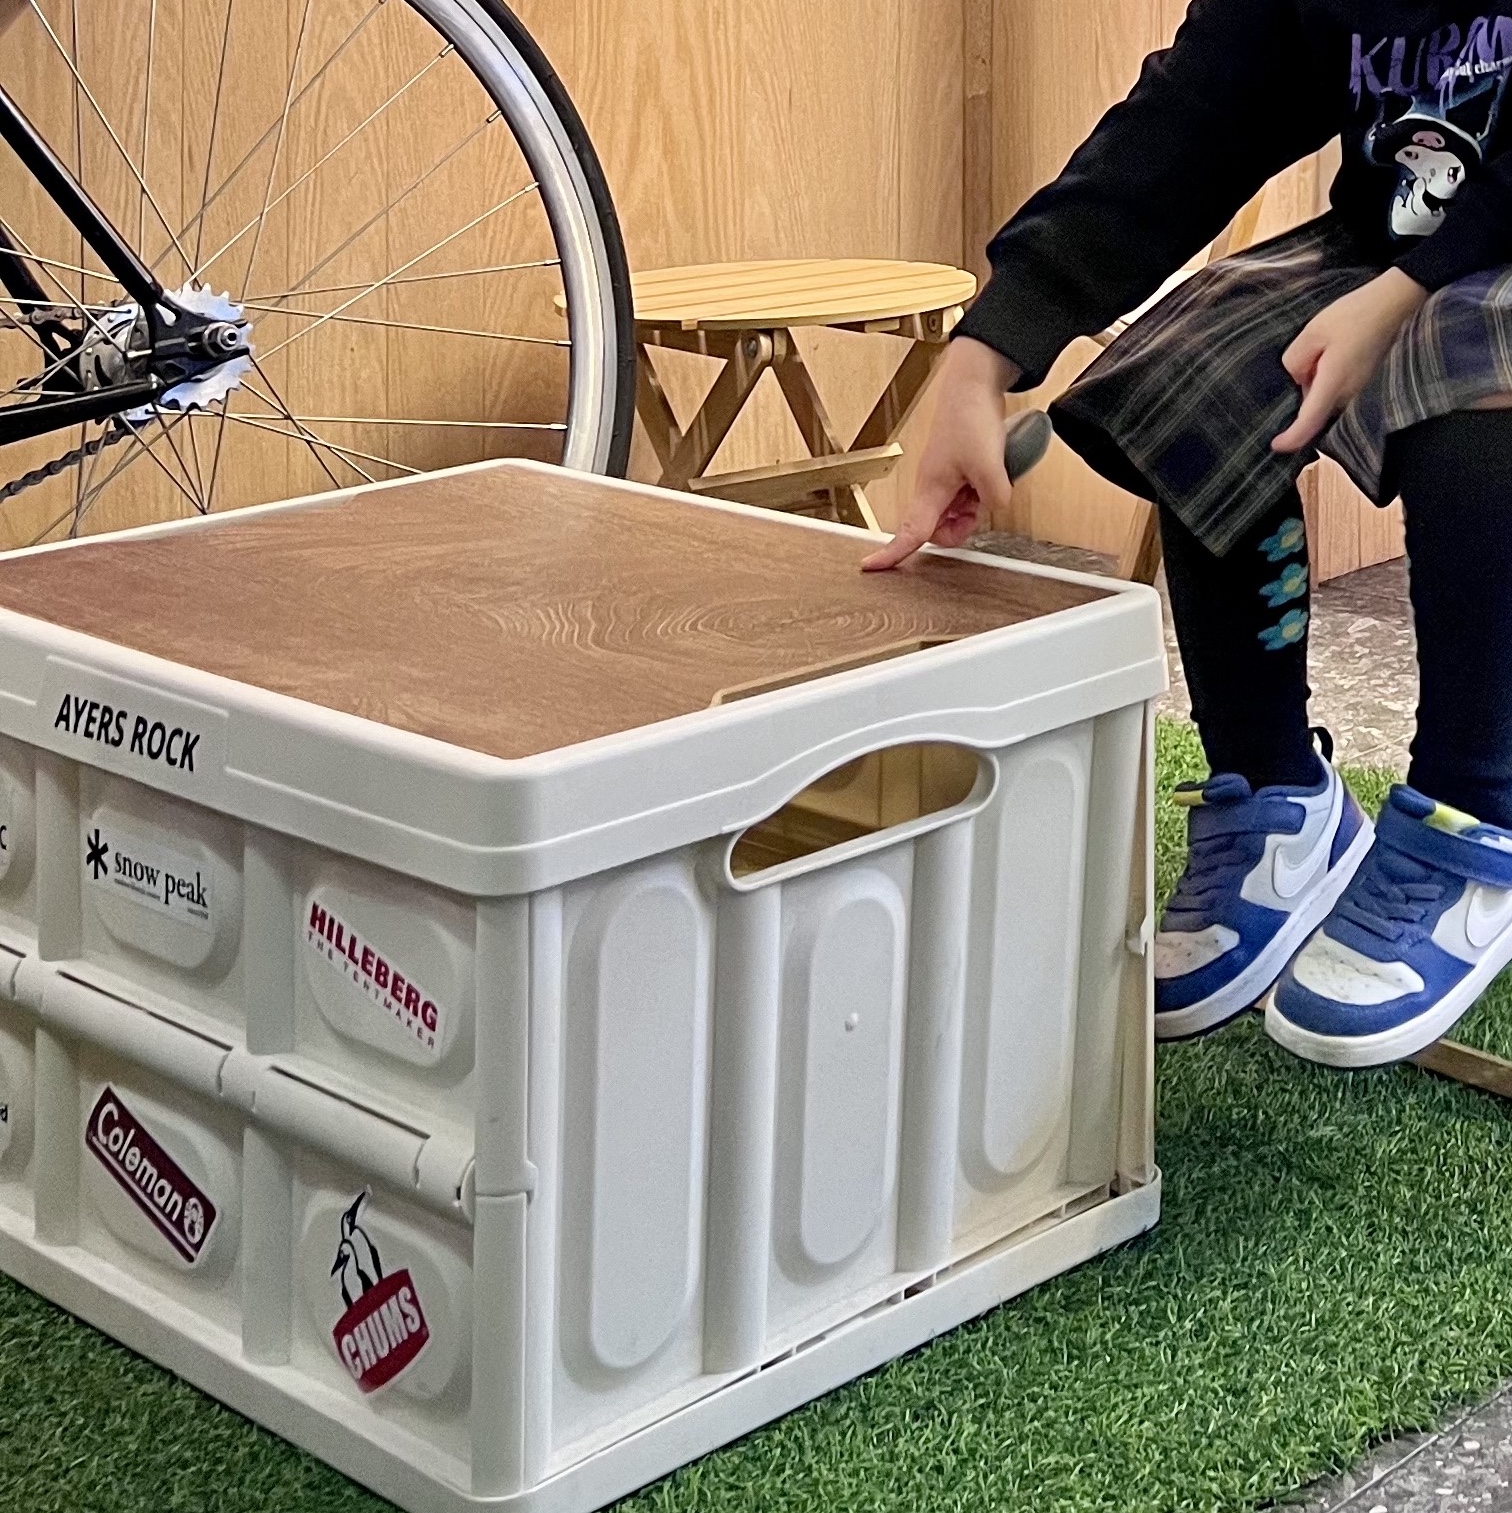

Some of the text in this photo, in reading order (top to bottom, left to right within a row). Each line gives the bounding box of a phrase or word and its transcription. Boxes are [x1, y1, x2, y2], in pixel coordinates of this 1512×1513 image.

[55, 694, 201, 772] AYERS ROCK
[115, 852, 160, 887] snow
[164, 872, 208, 908] peak
[308, 931, 435, 1049] THE TENTMAKER
[310, 901, 438, 1032] HILLEBERG
[98, 1102, 183, 1222] Coleman
[341, 1286, 421, 1380] CHUMS
